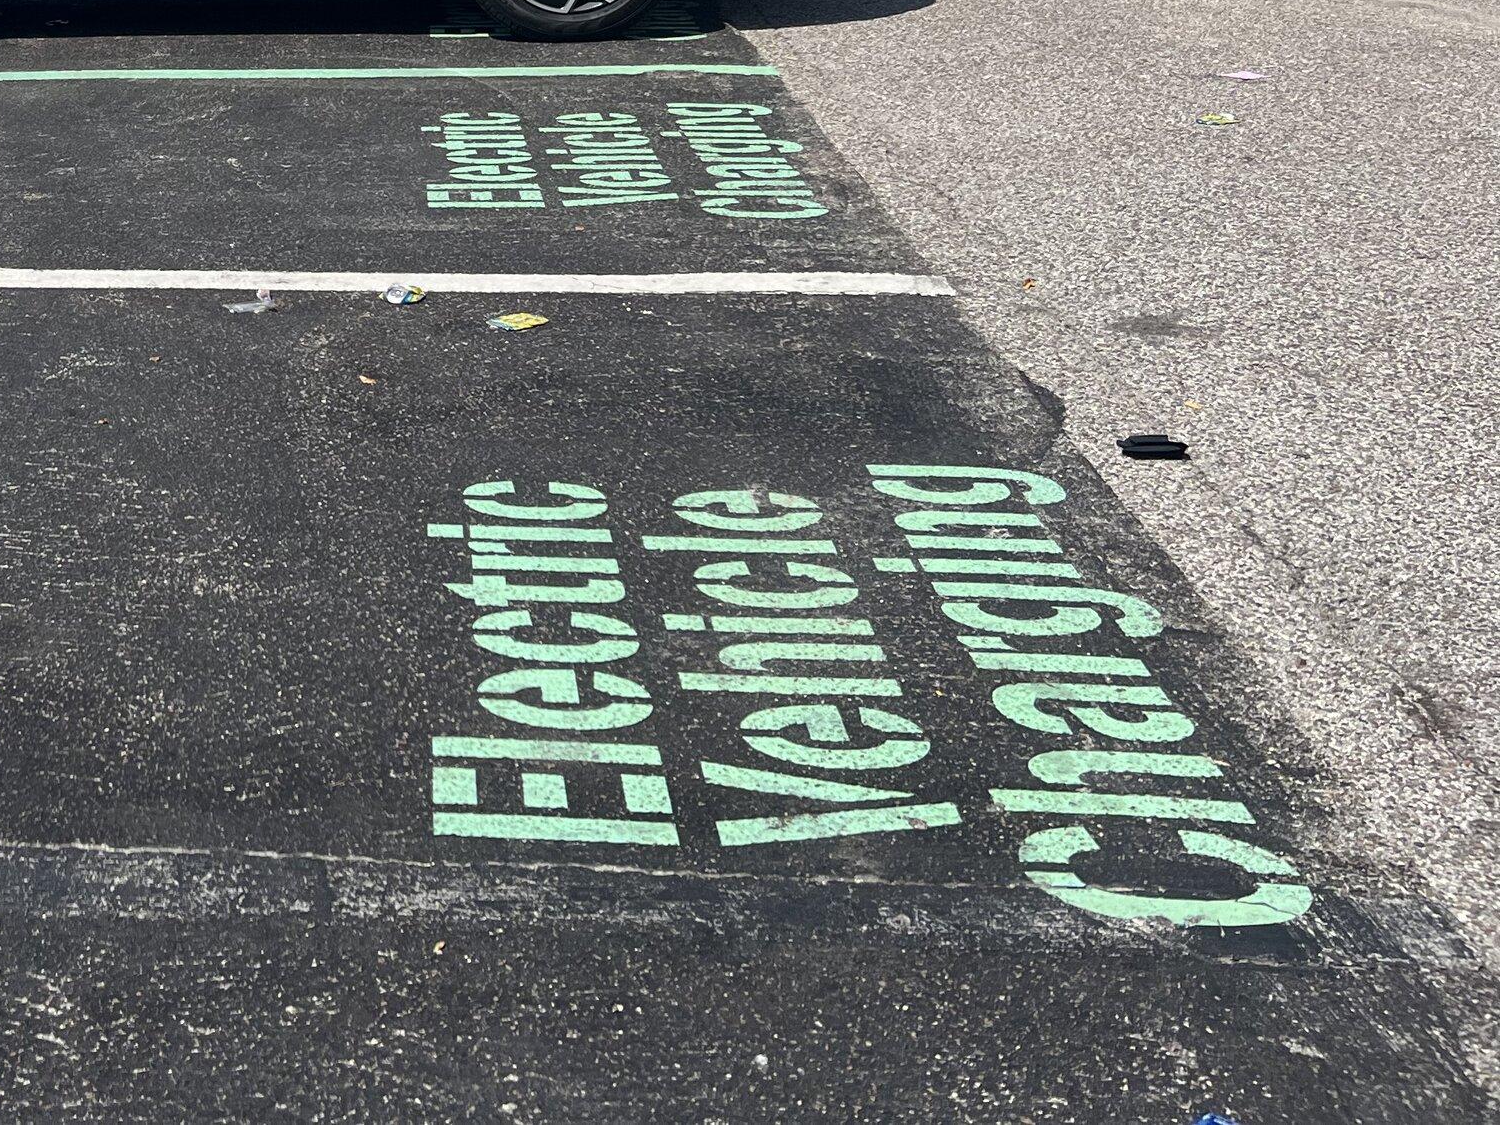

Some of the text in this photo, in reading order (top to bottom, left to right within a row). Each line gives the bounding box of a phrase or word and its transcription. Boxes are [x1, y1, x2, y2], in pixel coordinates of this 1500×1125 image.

[420, 112, 546, 208] Electric
[538, 112, 680, 208] Vehicle
[660, 102, 830, 220] Charging
[426, 480, 681, 847] Electric
[642, 489, 963, 847] Vehicle
[866, 463, 1314, 928] Charging
